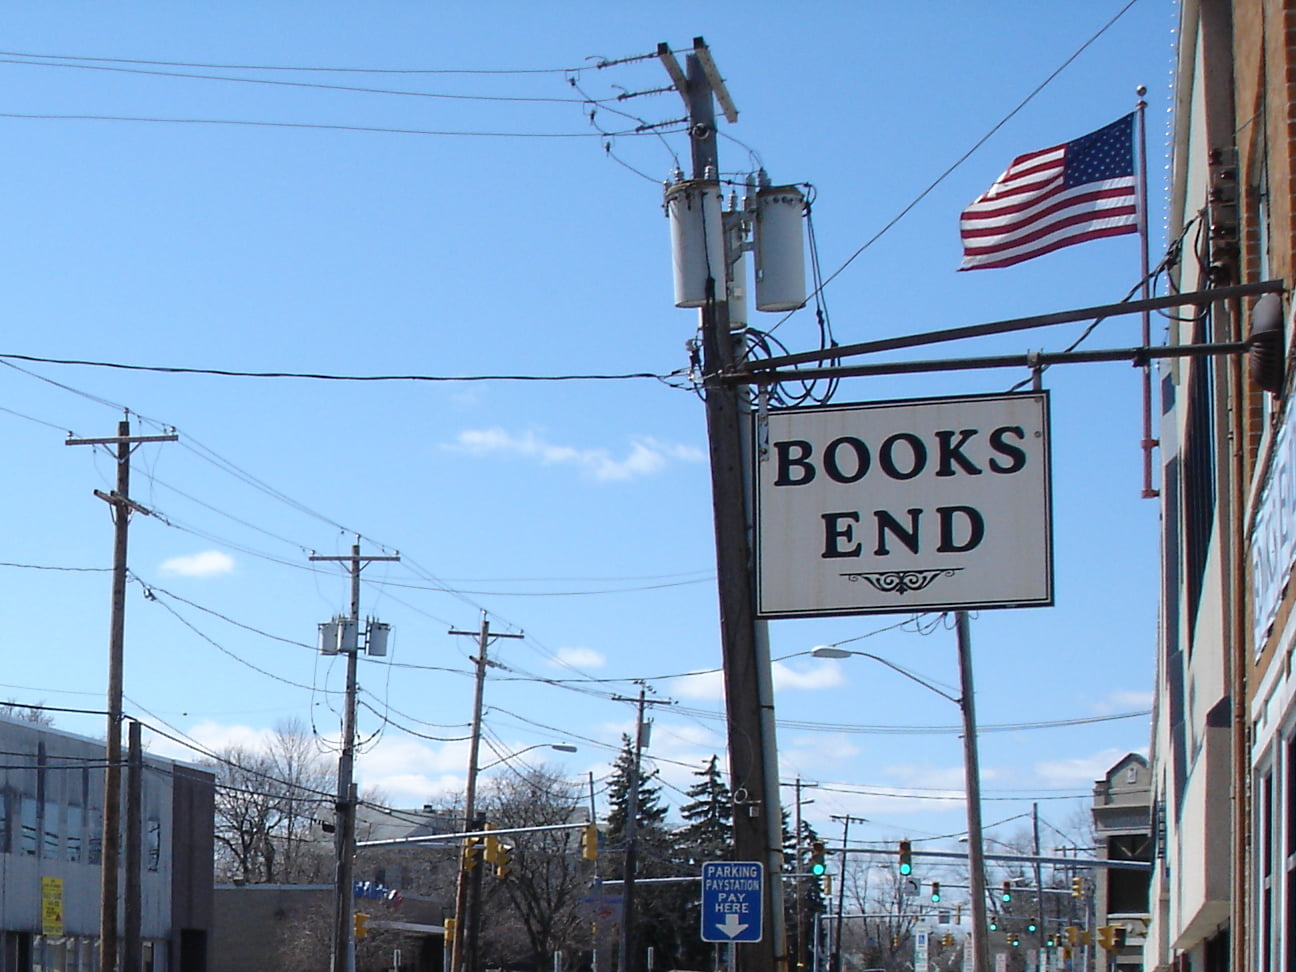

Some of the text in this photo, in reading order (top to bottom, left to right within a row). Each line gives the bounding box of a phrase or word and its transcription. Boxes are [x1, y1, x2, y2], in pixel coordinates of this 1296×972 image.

[773, 426, 1027, 487] BOOKS
[820, 505, 985, 558] END
[707, 865, 758, 878] PARKING
[705, 879, 760, 891] PAYSTATION
[718, 893, 746, 902] PAY
[715, 903, 749, 913] HERE
